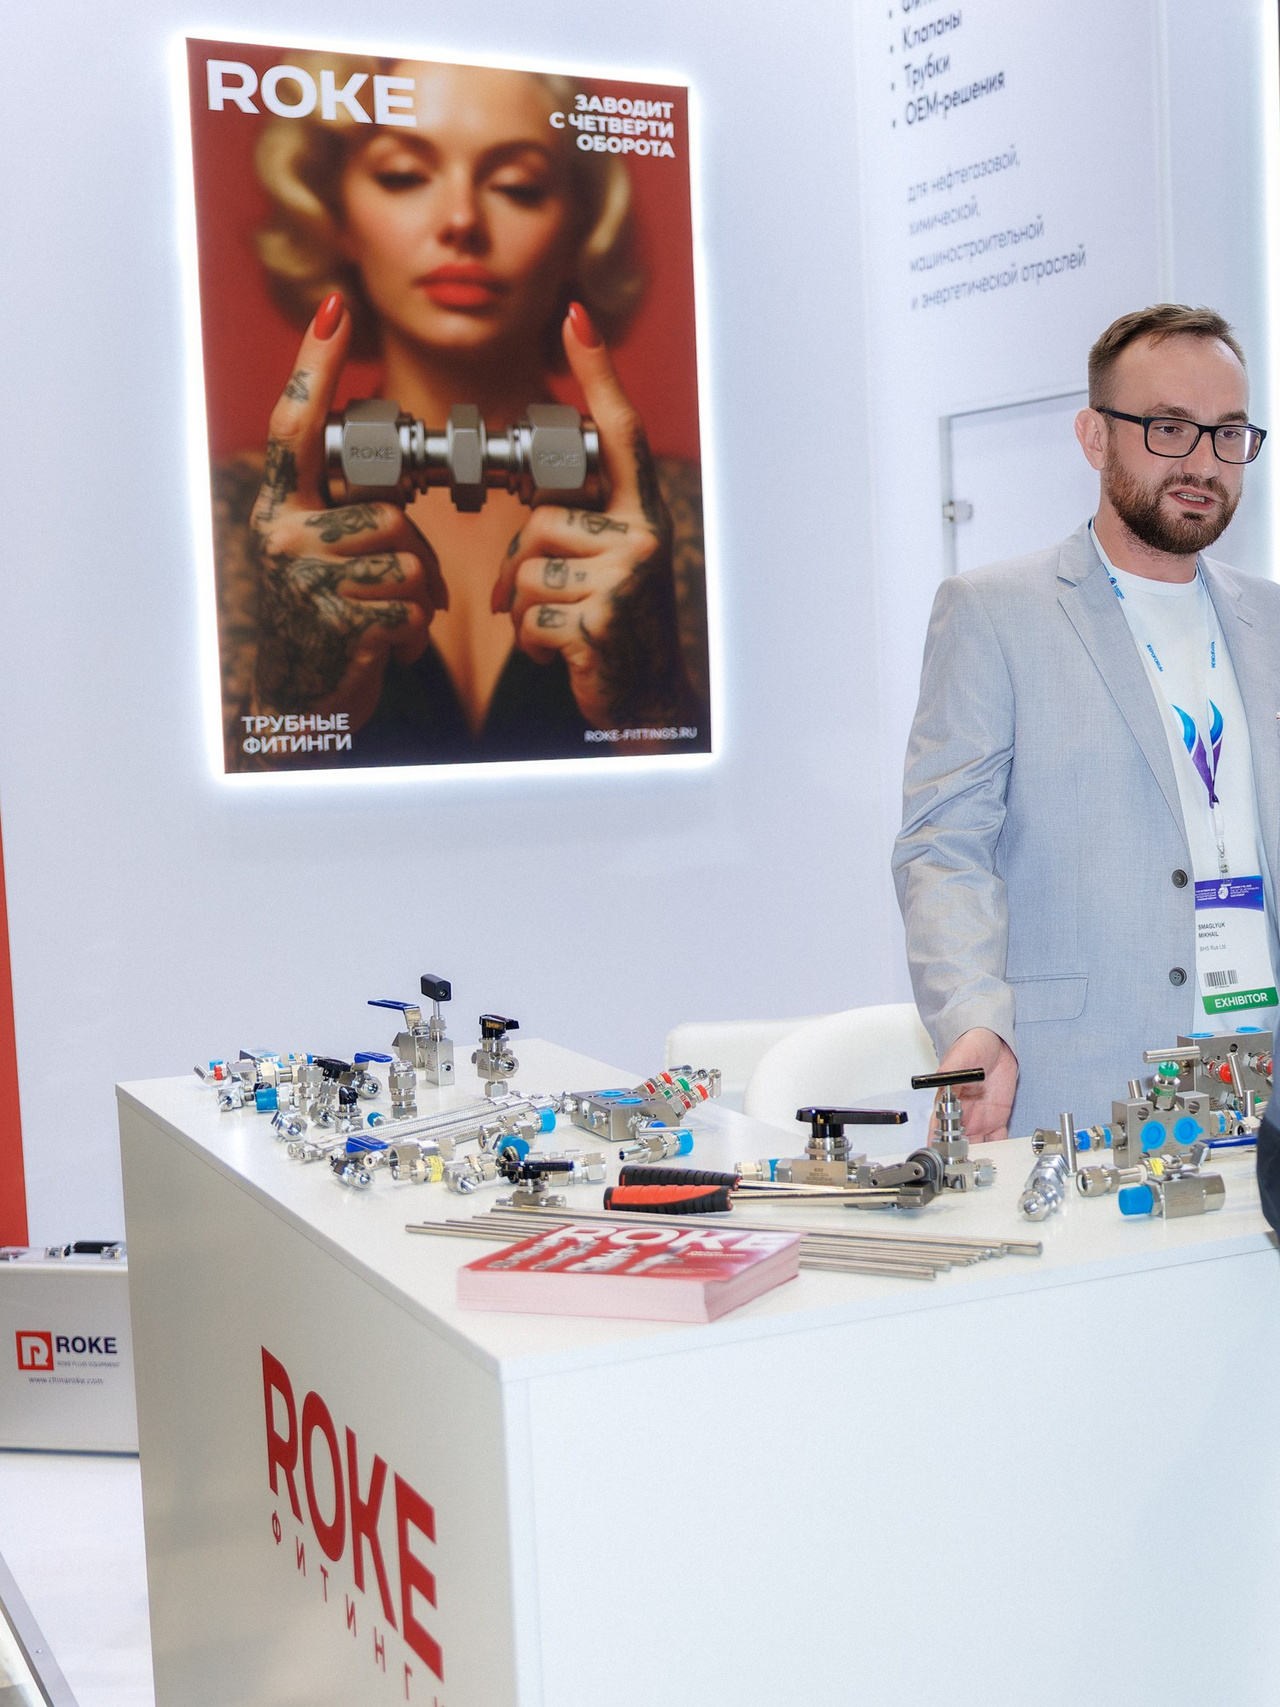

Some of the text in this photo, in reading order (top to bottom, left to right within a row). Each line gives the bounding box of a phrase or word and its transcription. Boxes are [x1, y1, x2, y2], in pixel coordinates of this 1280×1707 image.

[903, 10, 962, 51] Клапаны
[904, 53, 950, 93] Трубки
[206, 59, 417, 127] ROKE
[575, 94, 674, 119] ЗАВОДИТ
[549, 111, 674, 138] С ЧЕТВЕРТИ
[576, 134, 676, 158] ОБОРОТА
[909, 214, 1045, 274] машиностроительной
[1022, 243, 1088, 286] отраслей
[241, 712, 351, 734] ТРУБНЫЕ
[584, 727, 698, 743] ROKE-FITTINGS.RU
[242, 733, 352, 755] ФИТИНГИ
[1215, 993, 1268, 1009] EXHIBITOR
[545, 1225, 800, 1251] ROKE
[56, 1336, 118, 1354] ROKE
[261, 1345, 444, 1684] ROKE
[271, 1509, 446, 1707] ФИТИНГ
